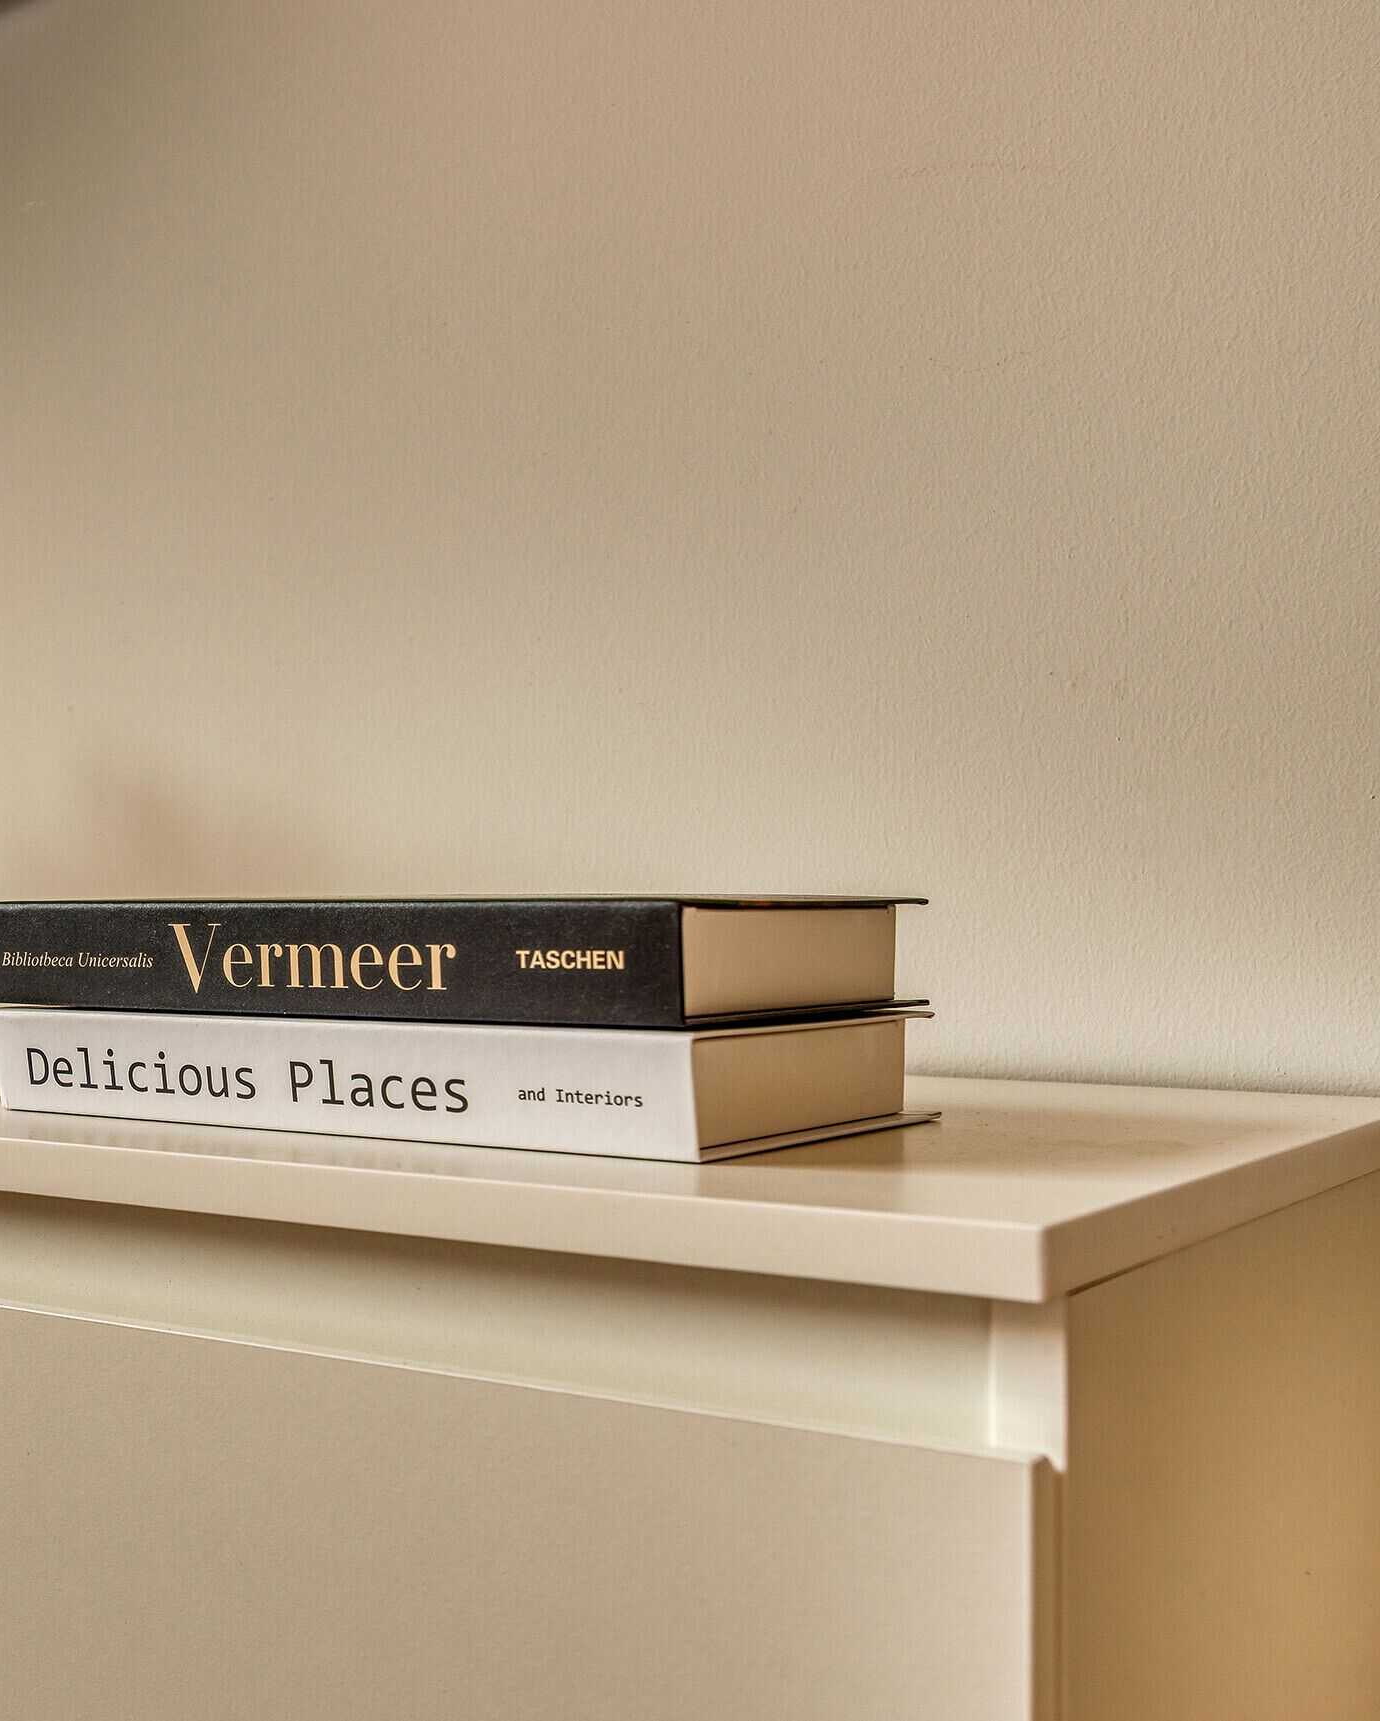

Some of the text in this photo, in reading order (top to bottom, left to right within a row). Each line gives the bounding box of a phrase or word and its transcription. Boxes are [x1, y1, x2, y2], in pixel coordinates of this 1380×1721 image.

[167, 923, 456, 994] Vermeer
[515, 949, 624, 970] TASCHEN
[26, 1046, 469, 1114] Delicious Places
[518, 1087, 643, 1108] and Interiors
